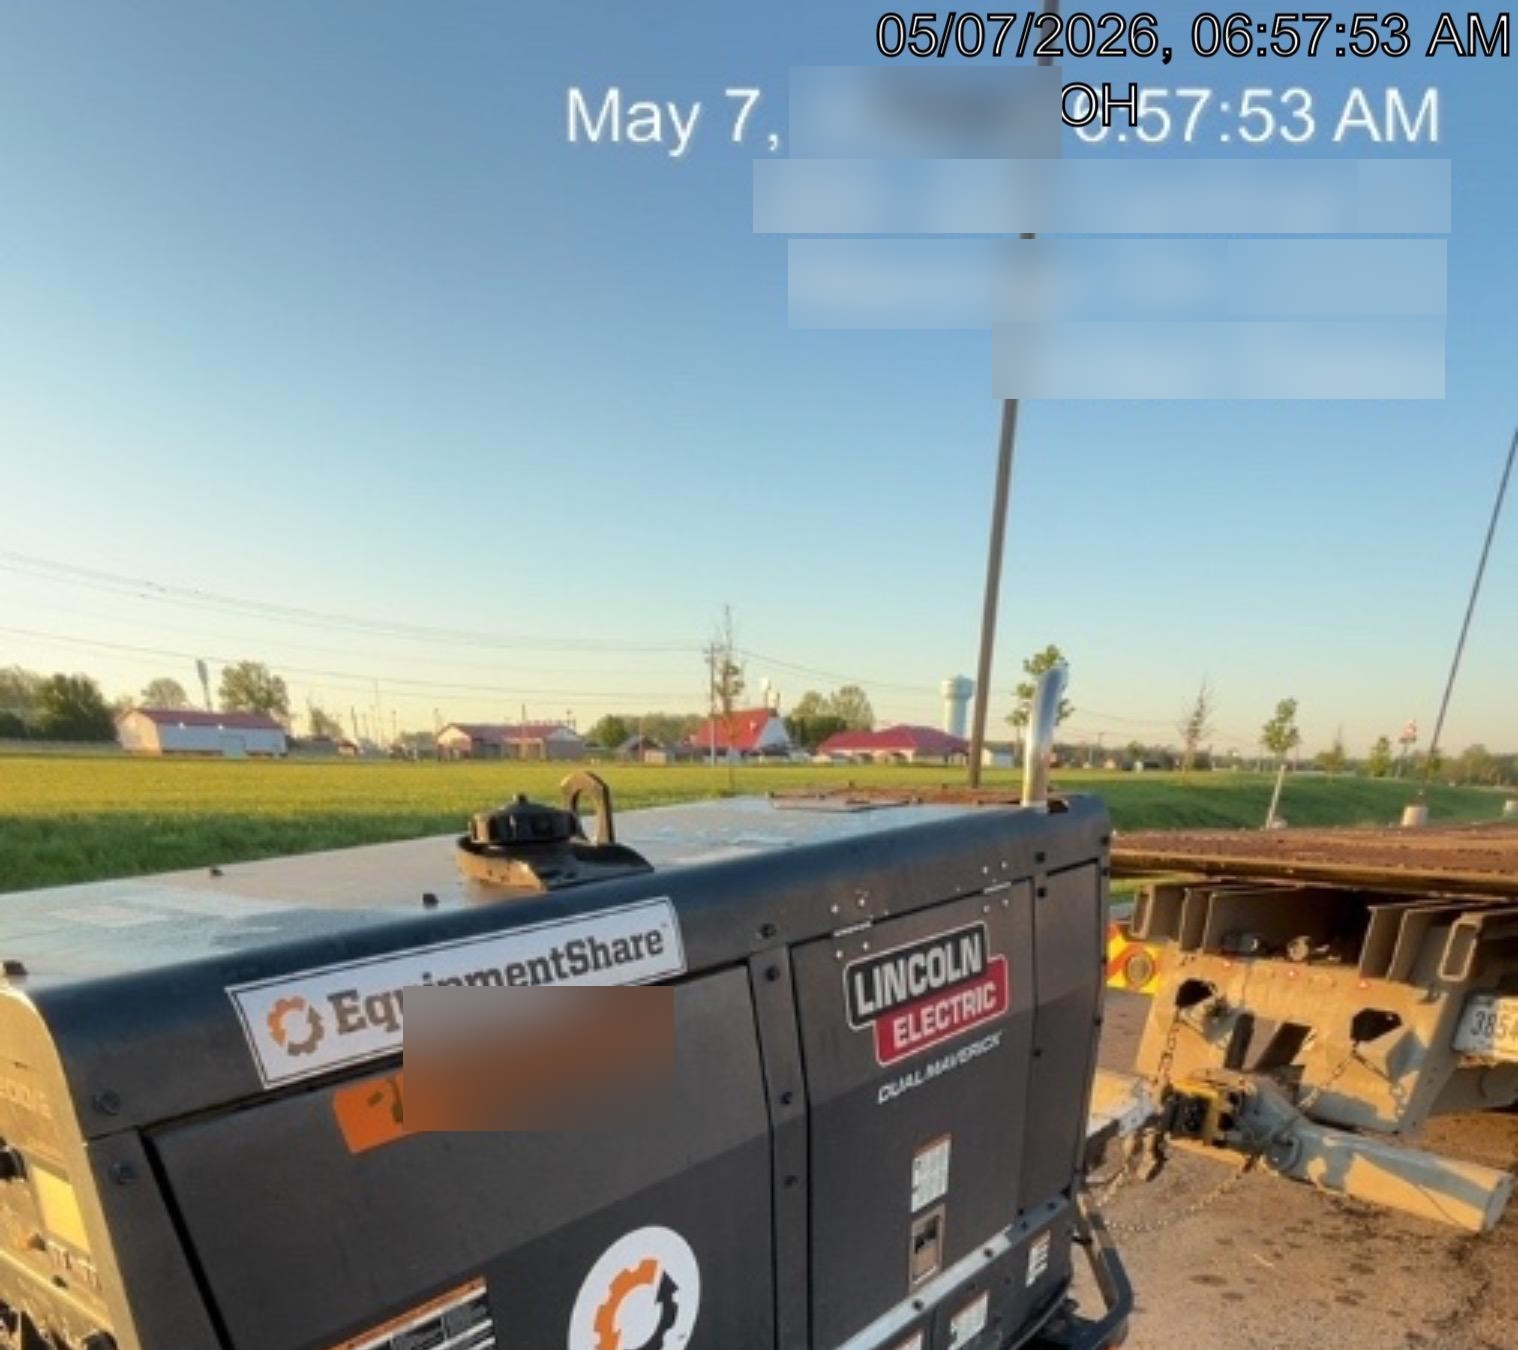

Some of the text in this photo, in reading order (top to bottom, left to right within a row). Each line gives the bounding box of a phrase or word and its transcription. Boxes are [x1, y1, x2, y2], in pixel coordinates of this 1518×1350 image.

[327, 927, 664, 1037] EqmentShare
[854, 932, 983, 1016] LINCOLN
[893, 980, 997, 1049] ELECTRIC
